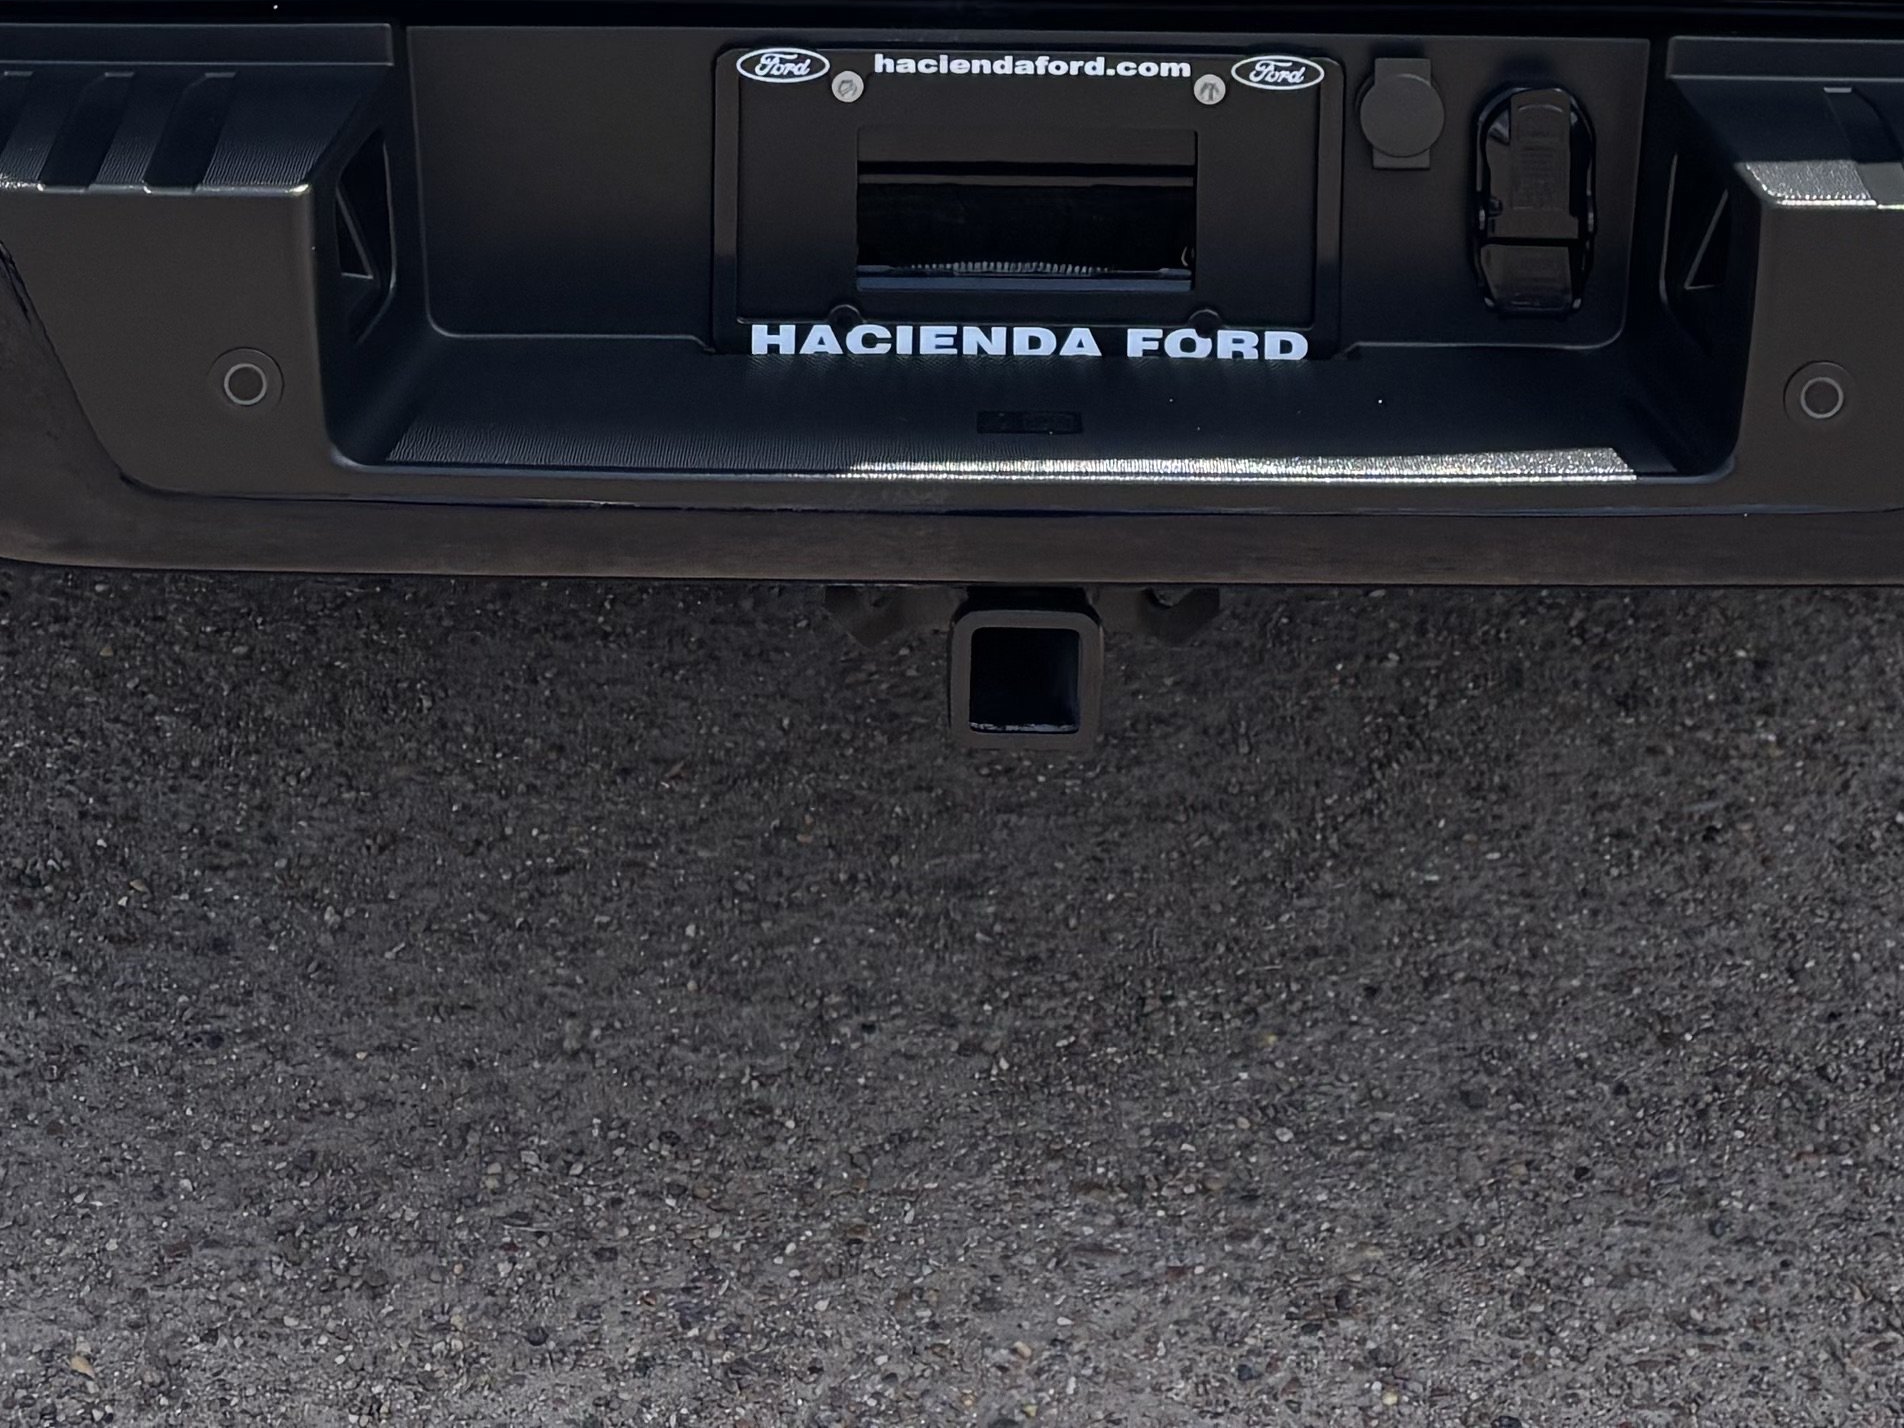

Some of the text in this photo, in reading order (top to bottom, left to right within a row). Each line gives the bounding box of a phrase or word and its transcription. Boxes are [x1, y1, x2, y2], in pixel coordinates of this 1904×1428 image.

[754, 53, 812, 77] Ford
[873, 53, 1192, 78] haciendaford.com
[1248, 60, 1306, 84] Ford
[751, 323, 1309, 361] HACIENDA FORD
